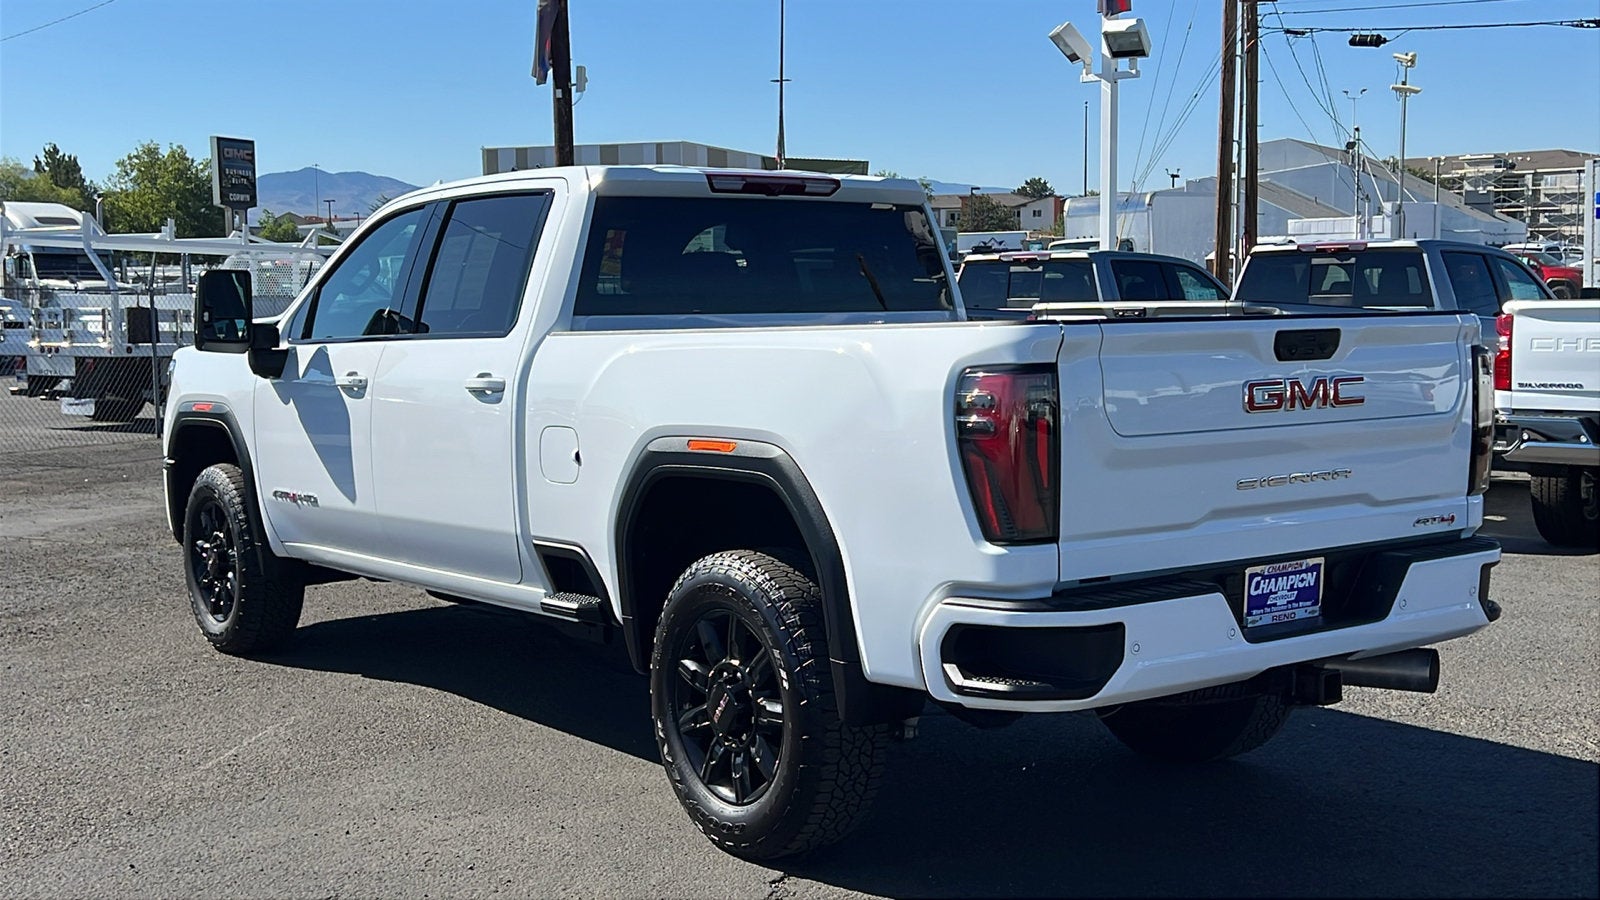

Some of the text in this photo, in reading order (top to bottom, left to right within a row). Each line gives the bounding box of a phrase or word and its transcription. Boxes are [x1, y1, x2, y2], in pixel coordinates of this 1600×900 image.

[223, 148, 252, 159] GMC
[1517, 382, 1585, 390] SILVERADO
[1242, 374, 1366, 414] GMC
[1236, 467, 1353, 491] SIERRA
[1267, 561, 1304, 573] CHAMPION
[1250, 572, 1316, 596] CHAMPION
[1271, 612, 1297, 622] RENO
